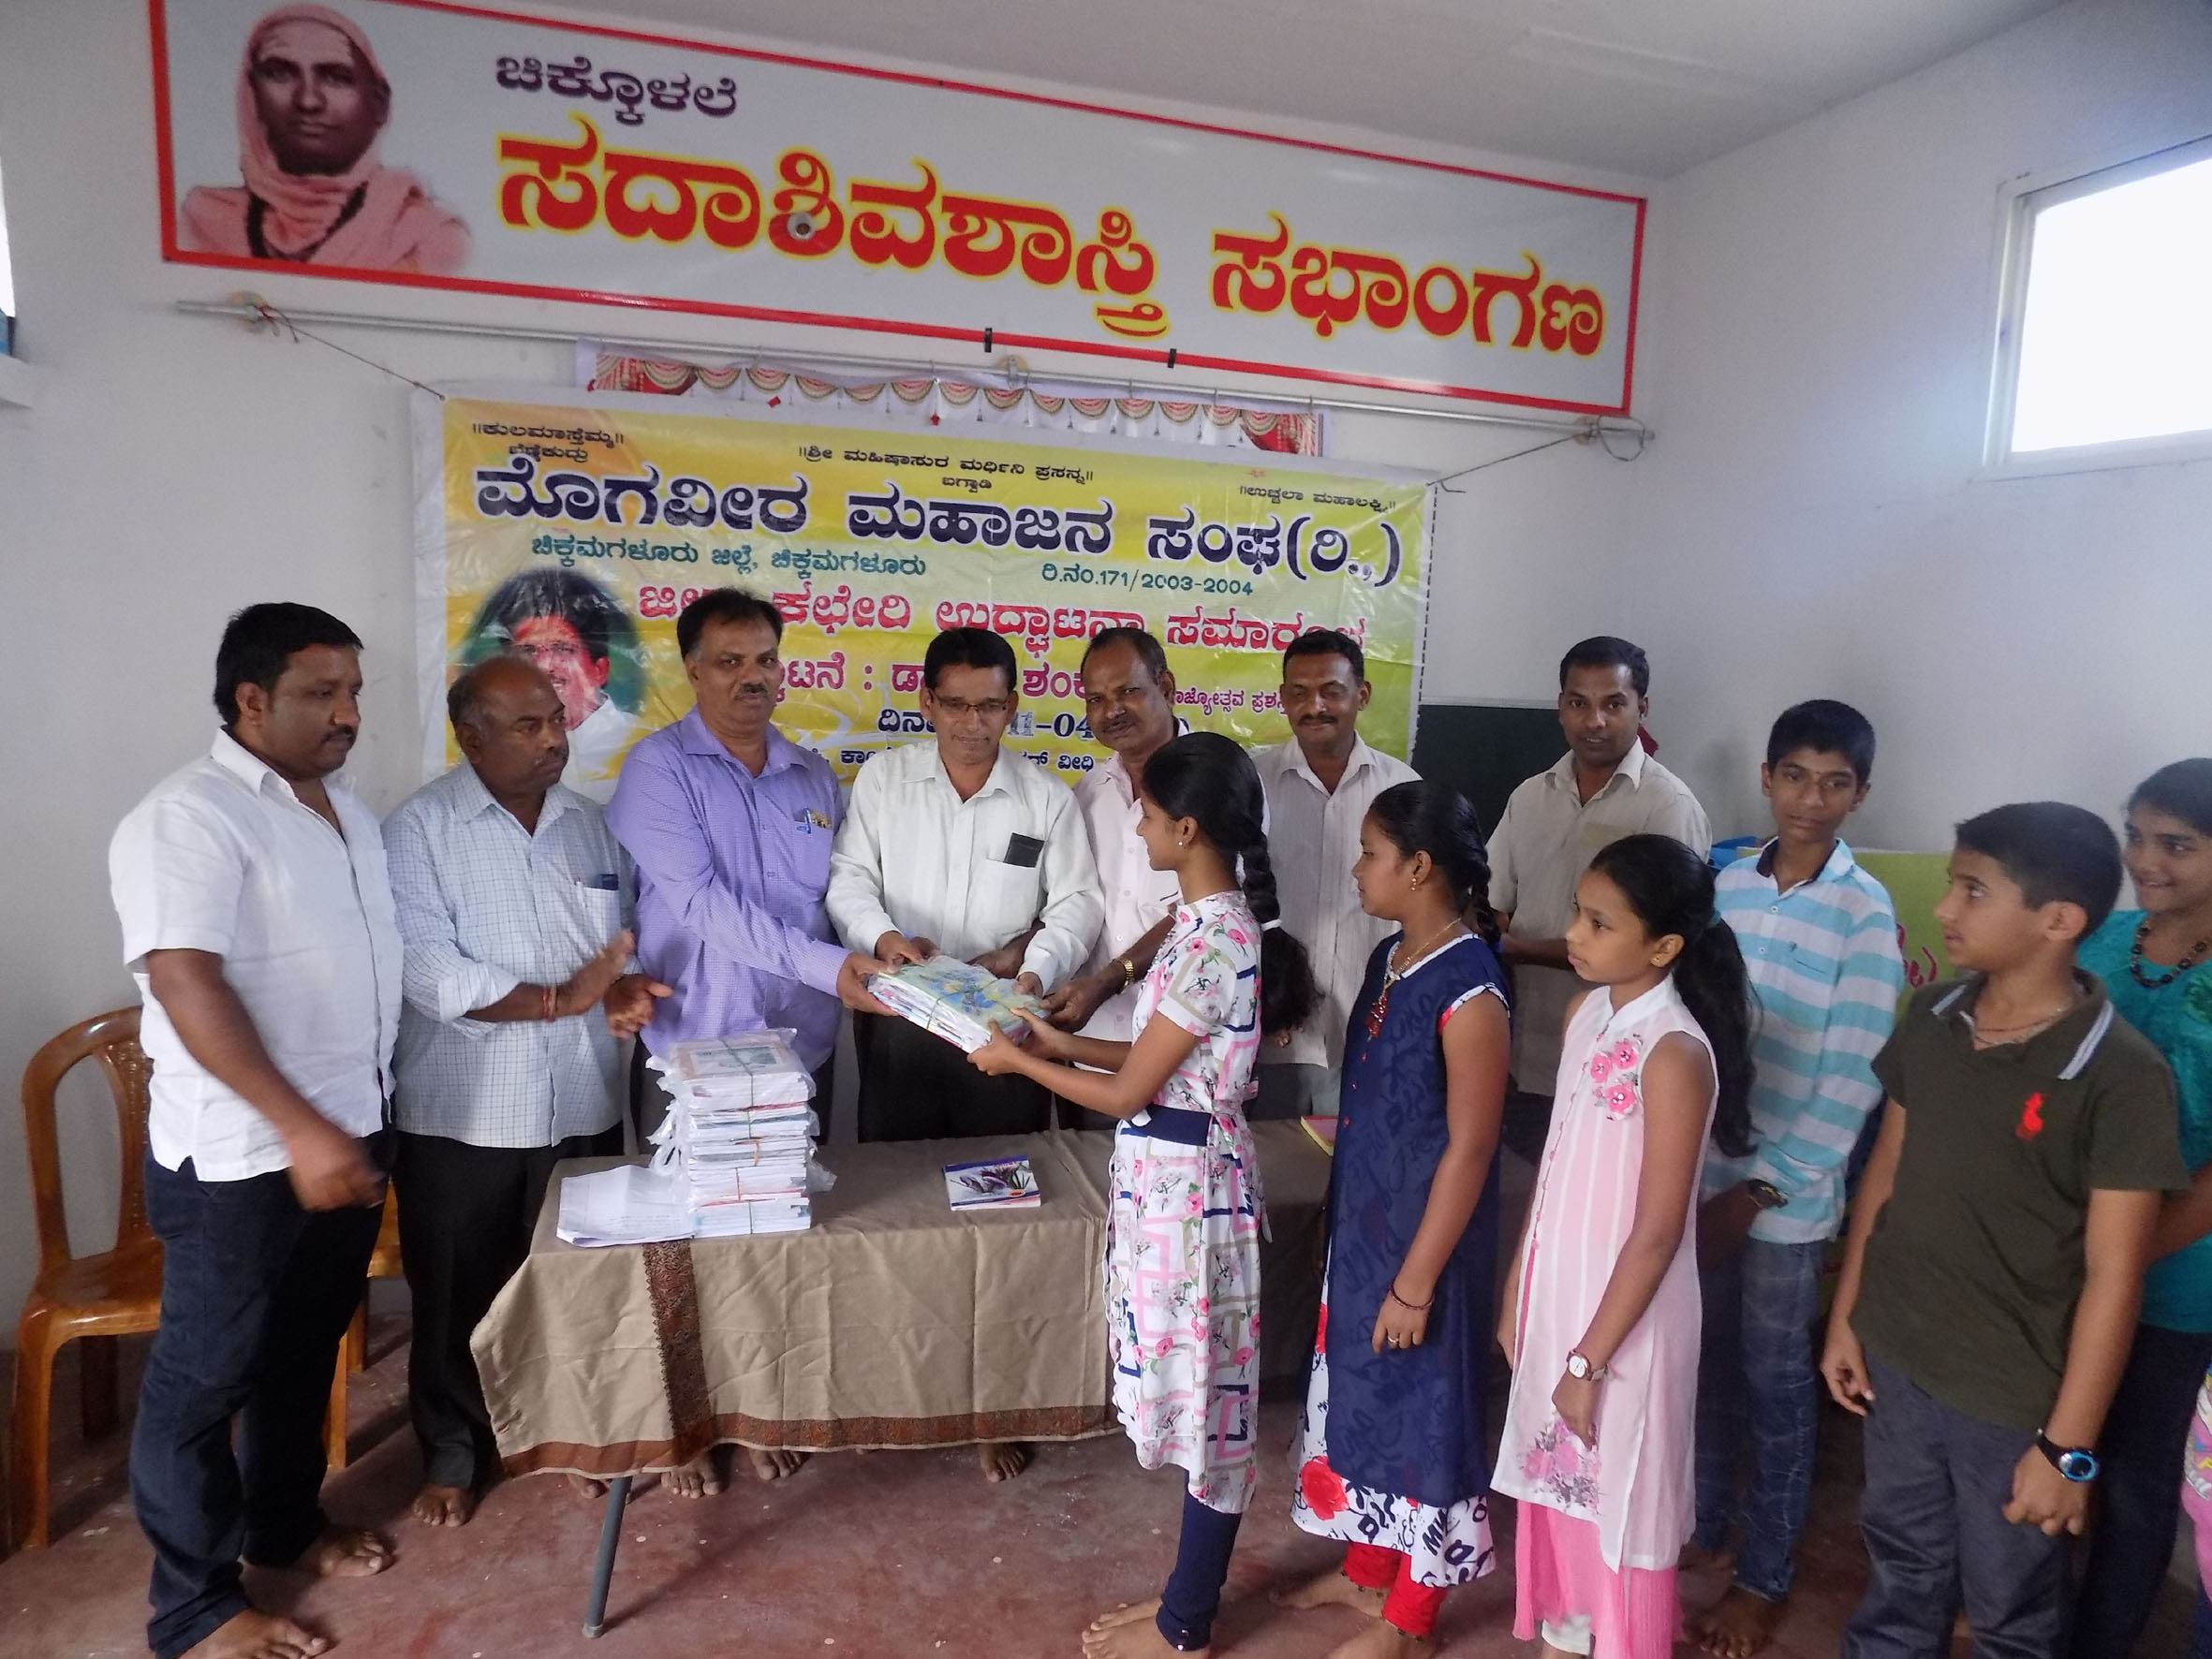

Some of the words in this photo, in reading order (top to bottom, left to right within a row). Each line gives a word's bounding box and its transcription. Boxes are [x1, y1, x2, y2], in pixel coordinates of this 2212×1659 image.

[497, 111, 1169, 337] ಸದಾಶಿವಶಾಸ್ತ್ರಿ
[1212, 212, 1605, 356] ಸಭಾಂಗಣ
[844, 449, 950, 468] ಮಹಿಷಾಸುರ
[476, 454, 808, 536] ಮೊಗವೀರ
[847, 481, 1113, 555] ಮಹಾಜನ
[531, 535, 700, 568] ಚಿಕ್ಕಮಗಳೂರು
[771, 549, 927, 580] ಚಿಕ್ಕಮಗಳೂರು
